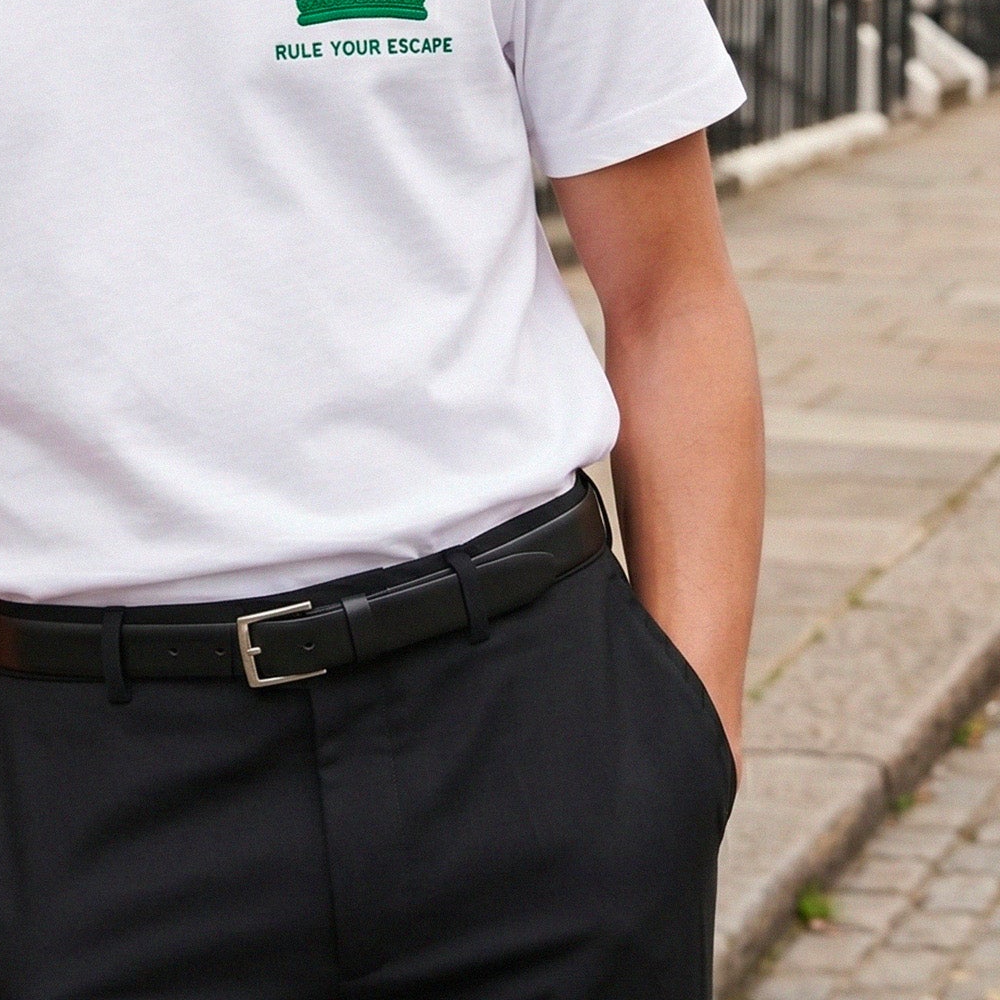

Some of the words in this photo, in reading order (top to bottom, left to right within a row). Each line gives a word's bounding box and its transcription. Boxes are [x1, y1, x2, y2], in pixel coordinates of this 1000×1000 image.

[275, 42, 323, 60] RULE
[330, 39, 381, 56] YOUR
[387, 37, 453, 54] ESCAPE
